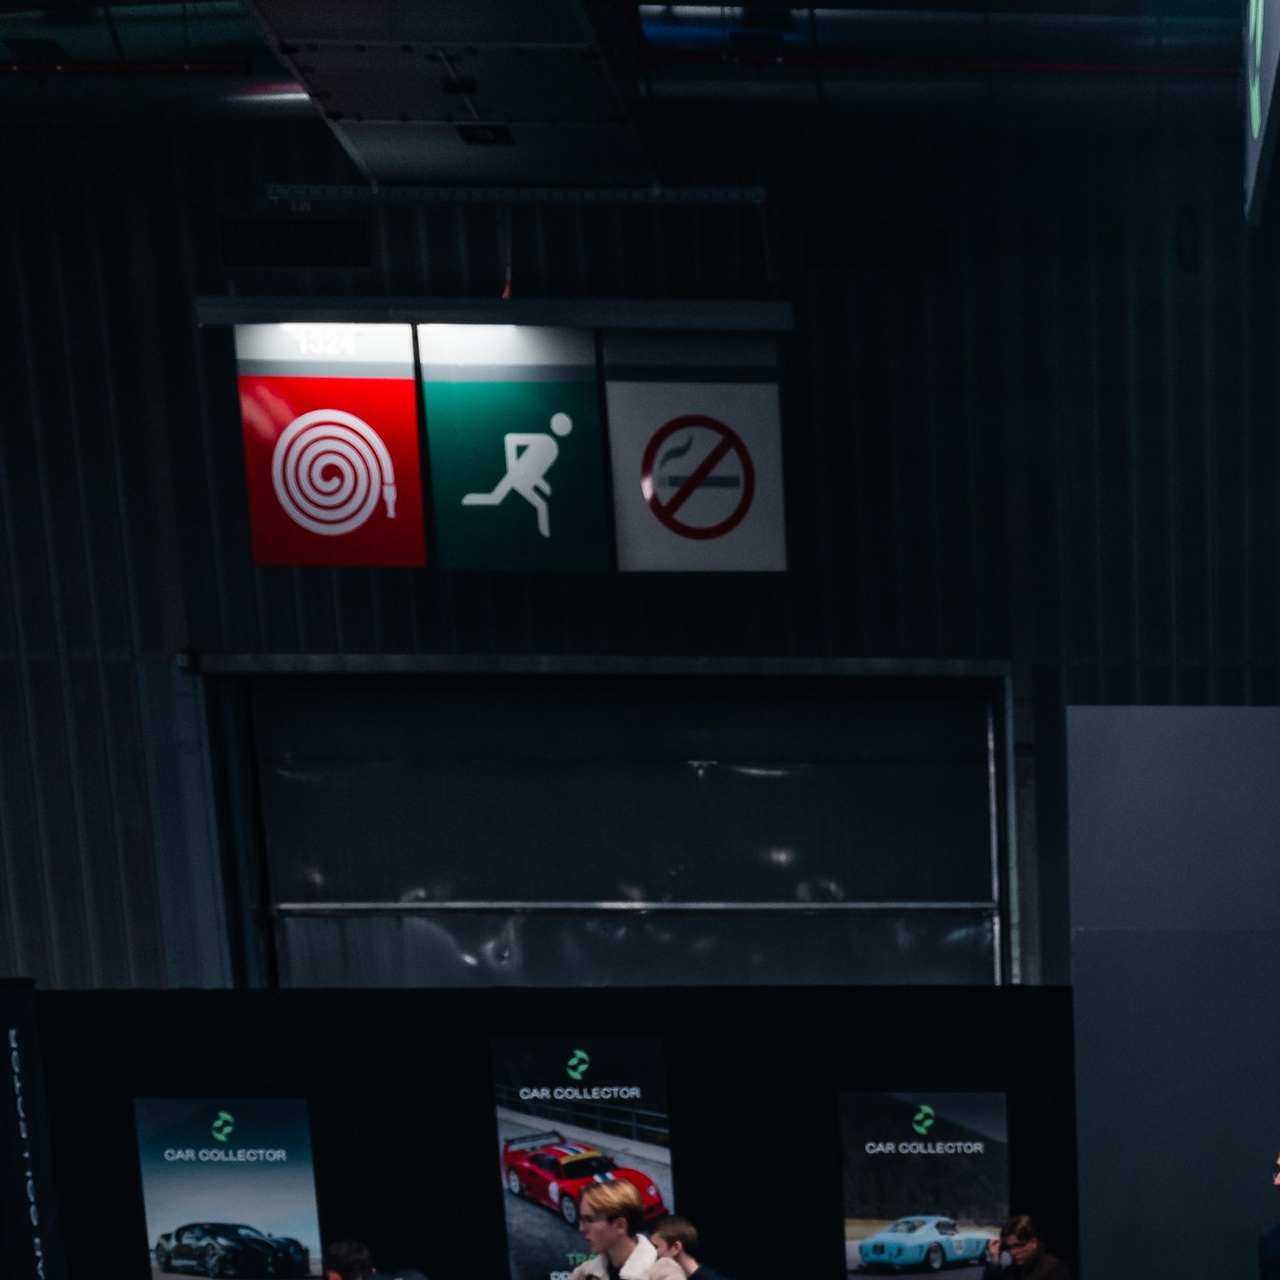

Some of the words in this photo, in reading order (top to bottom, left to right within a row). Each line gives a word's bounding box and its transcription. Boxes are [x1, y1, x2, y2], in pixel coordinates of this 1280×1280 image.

[519, 1087, 551, 1100] CAR
[553, 1086, 641, 1100] COLLECTOR
[864, 1141, 896, 1154] CAR
[898, 1141, 984, 1154] COLLECTOR
[163, 1148, 196, 1162] CAR
[198, 1148, 287, 1162] COLLECTOR
